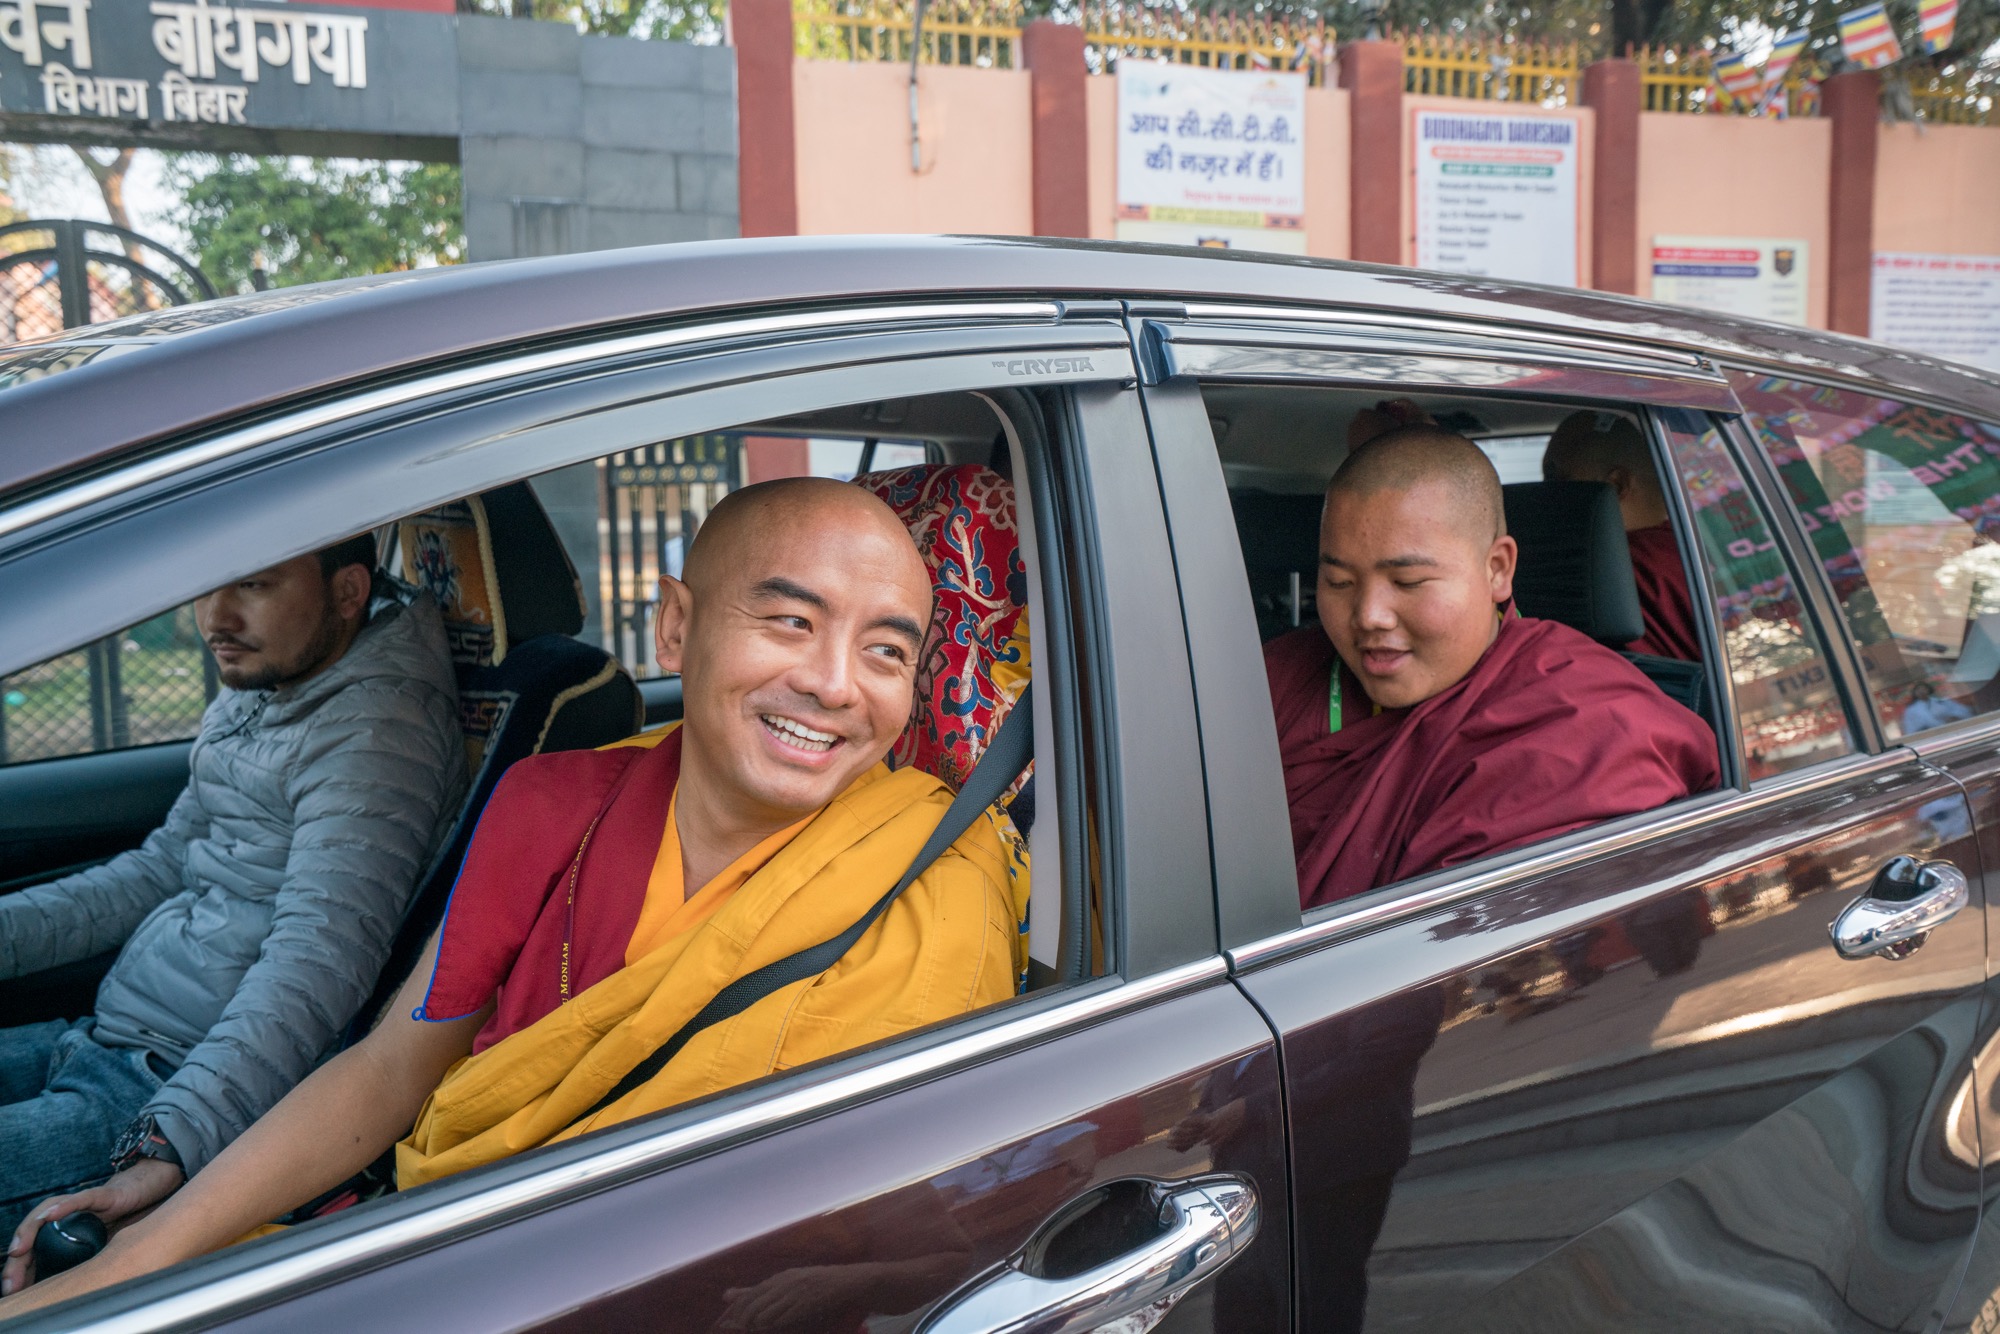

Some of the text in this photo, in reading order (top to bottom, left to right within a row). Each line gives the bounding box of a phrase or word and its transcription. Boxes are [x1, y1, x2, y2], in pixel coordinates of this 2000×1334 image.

[39, 61, 149, 119] विभाग
[158, 69, 248, 125] बिहार
[1129, 112, 1169, 134] आप
[1144, 143, 1172, 172] की
[1235, 150, 1254, 177] में
[991, 356, 1095, 376] FOR CRYSTA
[560, 942, 569, 995] MONLAM
